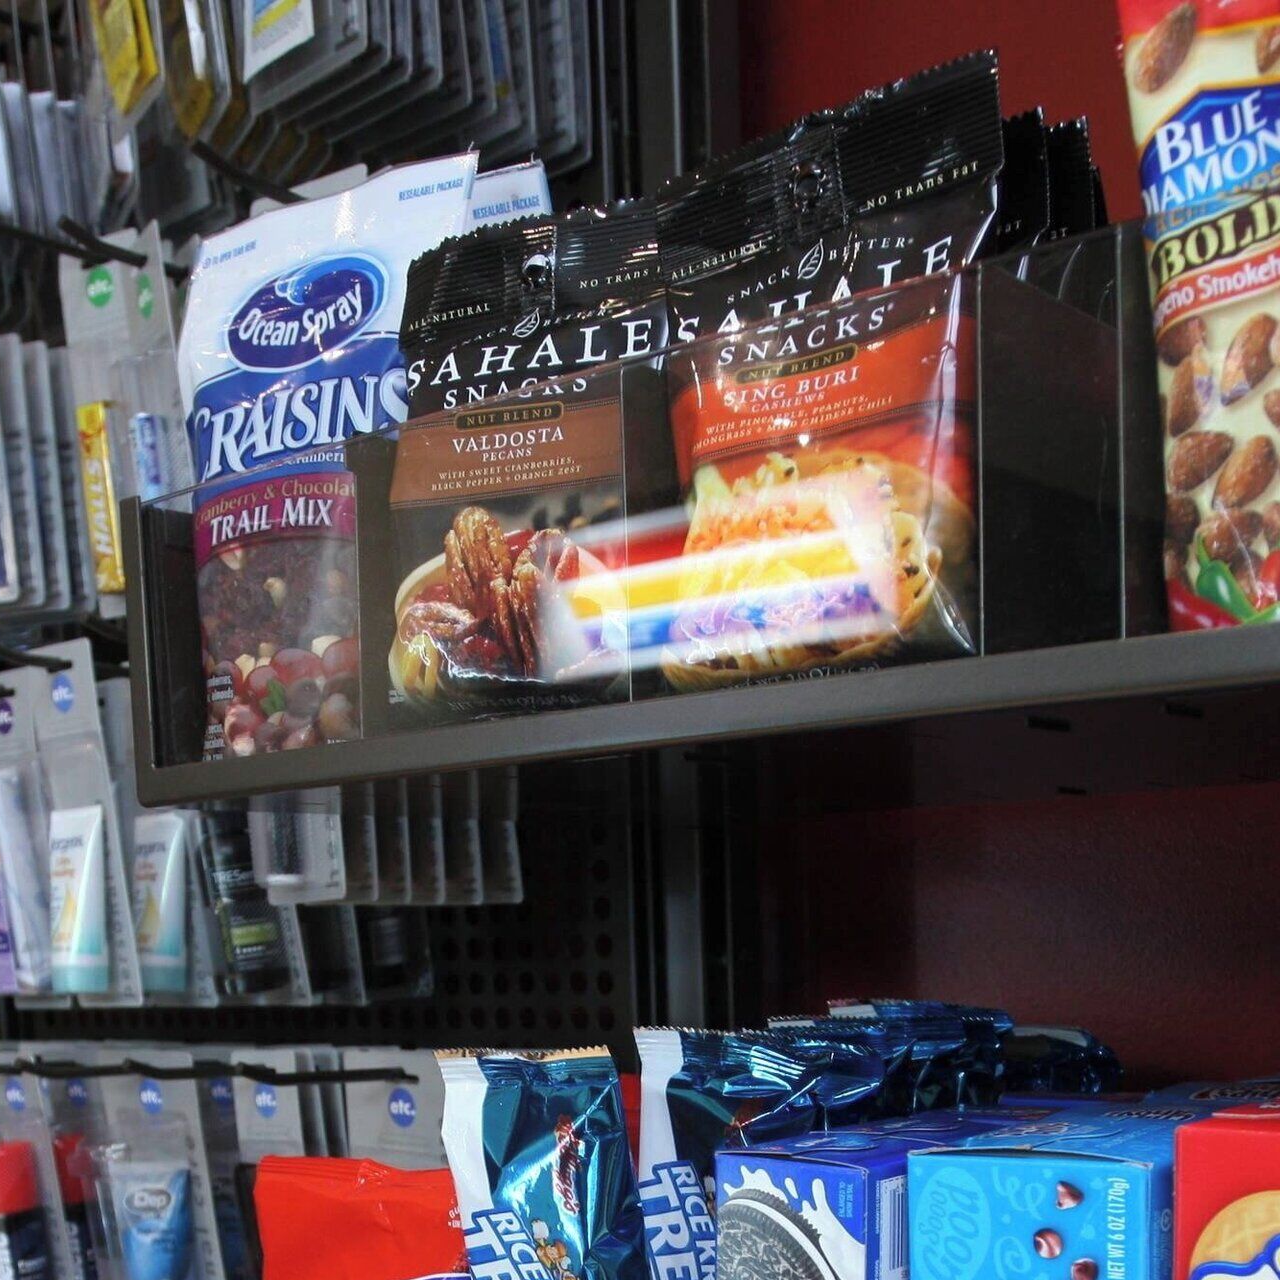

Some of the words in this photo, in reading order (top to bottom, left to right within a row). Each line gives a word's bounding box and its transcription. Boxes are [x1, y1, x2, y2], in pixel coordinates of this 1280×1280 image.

[1155, 90, 1268, 174] BLUE
[865, 195, 888, 209] NO
[579, 278, 599, 289] NO
[726, 265, 791, 305] SNACK
[238, 307, 299, 346] Ocean
[301, 283, 363, 352] Spray
[718, 304, 887, 366] SNACKS
[407, 319, 652, 396] SAHALE
[748, 365, 783, 380] NUT
[790, 351, 846, 374] BLEND
[443, 375, 588, 410] SNACKS
[724, 382, 787, 408] SING
[798, 366, 861, 395] BURI
[750, 391, 826, 413] CASHEWS
[465, 413, 496, 426] NUT
[503, 407, 553, 423] BLEND
[452, 426, 565, 453] VALDOSTA
[482, 447, 533, 463] PECANS
[469, 465, 502, 478] SWEET
[281, 478, 355, 498] Chocolat
[82, 459, 115, 554] HALLS
[210, 504, 272, 547] TRAIL
[281, 497, 333, 529] MIX
[390, 1100, 416, 1116] etc.
[672, 1164, 716, 1234] RICE
[1107, 1177, 1131, 1212] (170g)
[1108, 1213, 1125, 1231] OZ
[1108, 1232, 1125, 1242] 6
[1107, 1243, 1126, 1261] WT
[1107, 1262, 1126, 1280] NET
